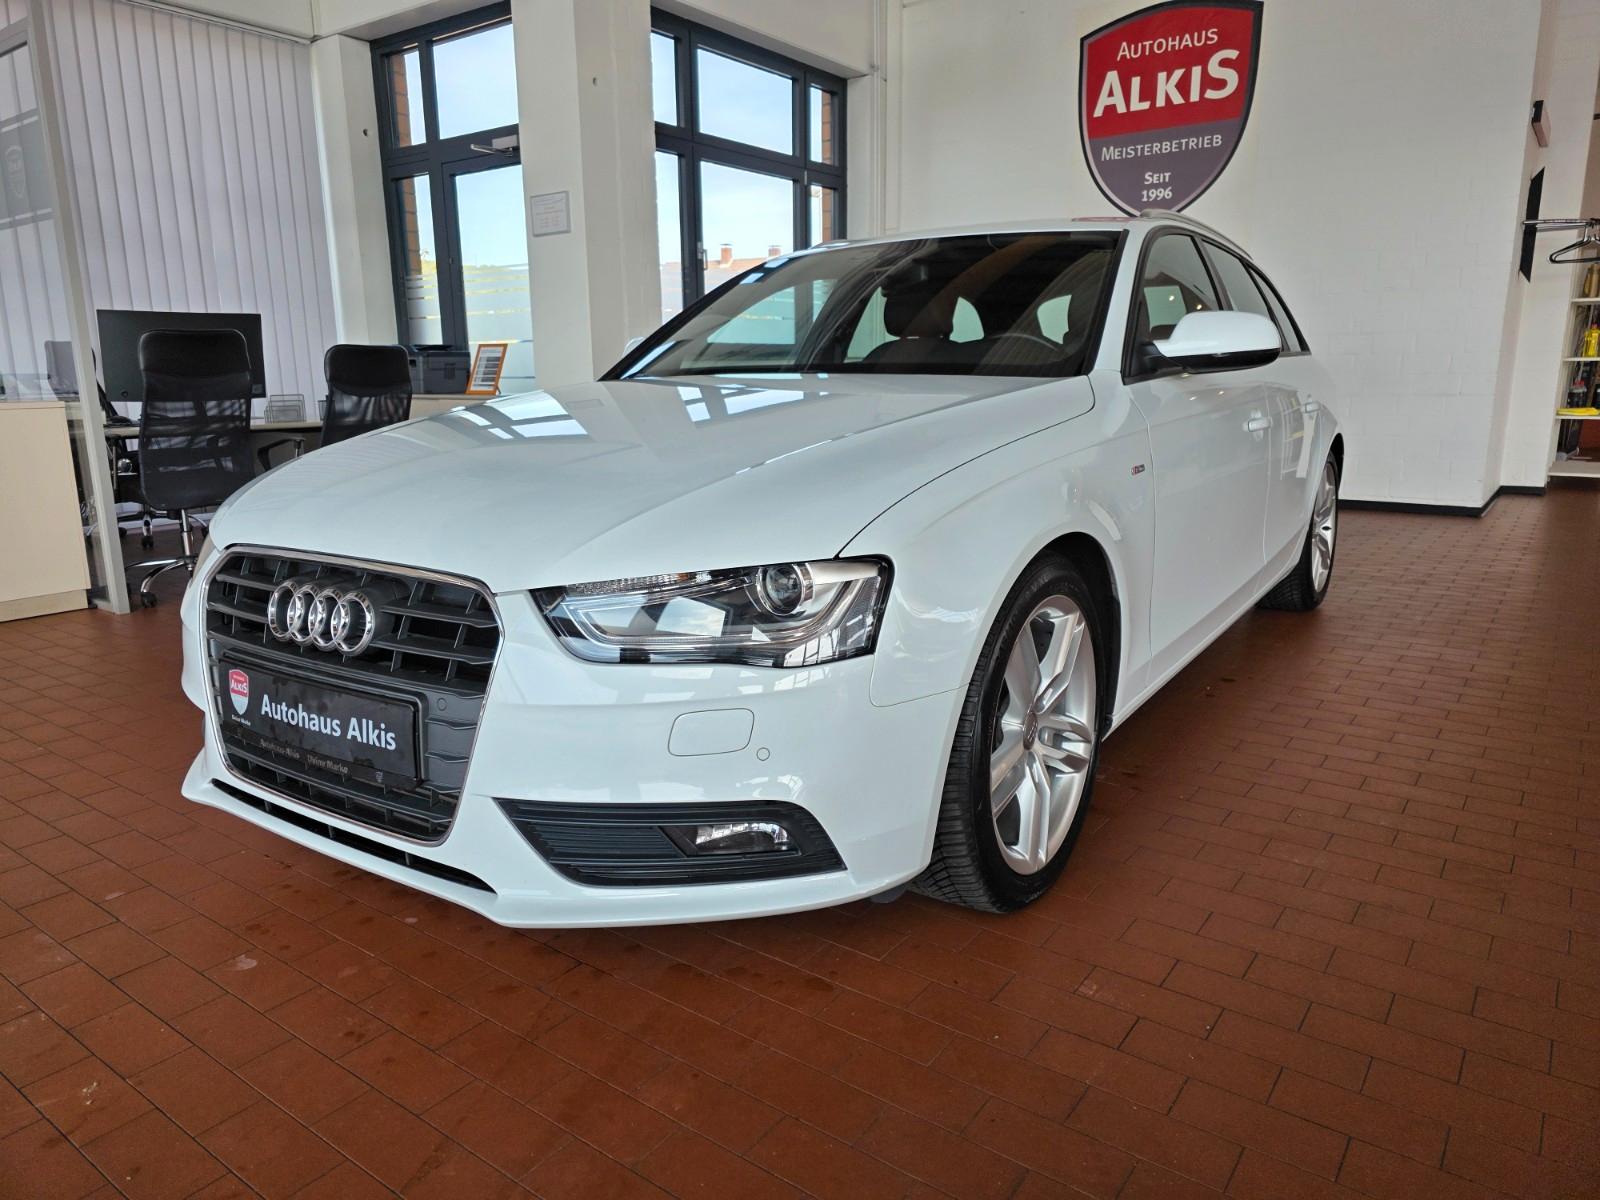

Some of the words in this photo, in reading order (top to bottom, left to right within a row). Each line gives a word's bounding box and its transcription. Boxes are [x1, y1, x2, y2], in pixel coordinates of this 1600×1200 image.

[1117, 28, 1219, 62] AUTOHAUS
[1101, 134, 1222, 162] MEISTERBETRIEB
[1144, 172, 1171, 185] SEIT
[1141, 187, 1173, 202] 1996
[261, 694, 341, 737] Autohaus
[346, 717, 397, 750] Alkis
